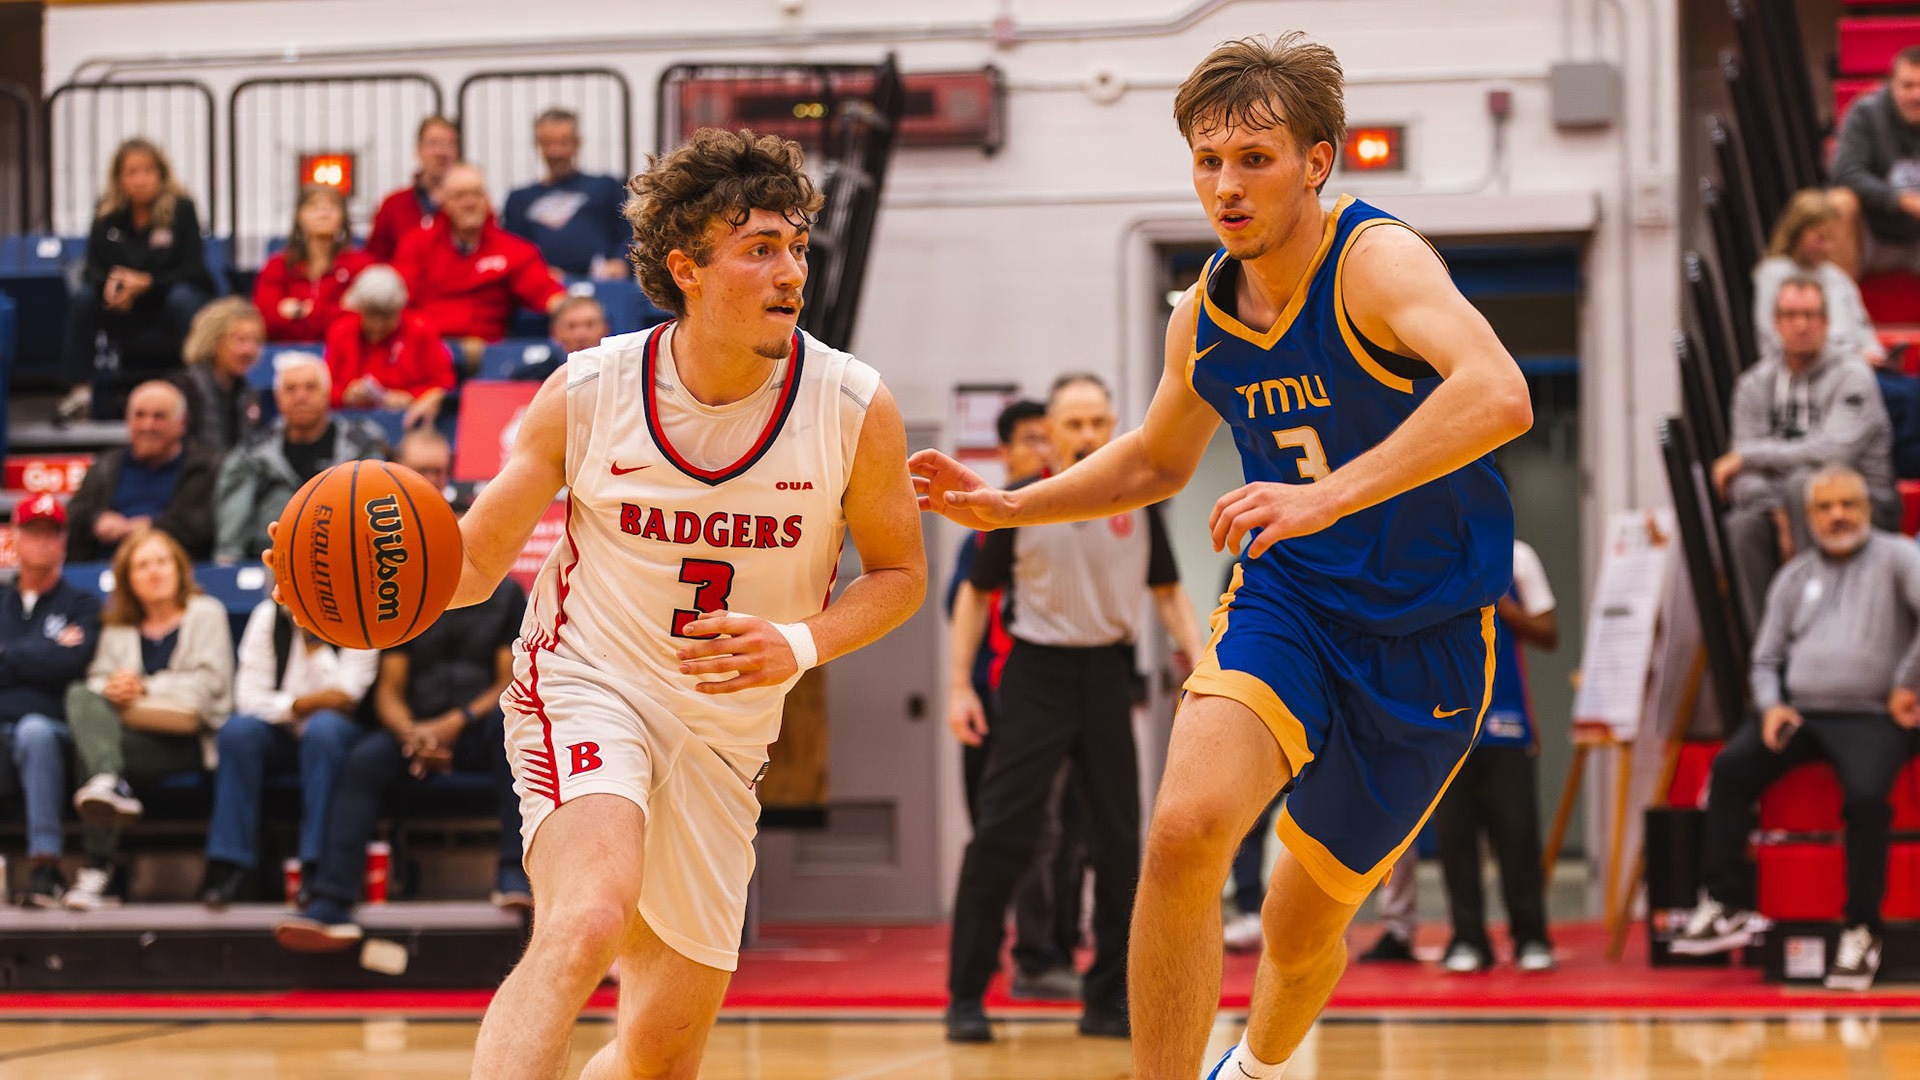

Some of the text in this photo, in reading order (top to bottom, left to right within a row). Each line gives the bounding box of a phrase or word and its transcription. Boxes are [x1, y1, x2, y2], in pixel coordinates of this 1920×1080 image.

[1234, 375, 1331, 418] TMU
[1272, 425, 1332, 482] 3
[775, 481, 814, 491] OUA
[620, 502, 803, 549] BADGERS
[313, 504, 343, 624] EVOLUTION
[364, 493, 408, 622] Wilson
[670, 557, 735, 640] 3
[565, 741, 603, 777] B
